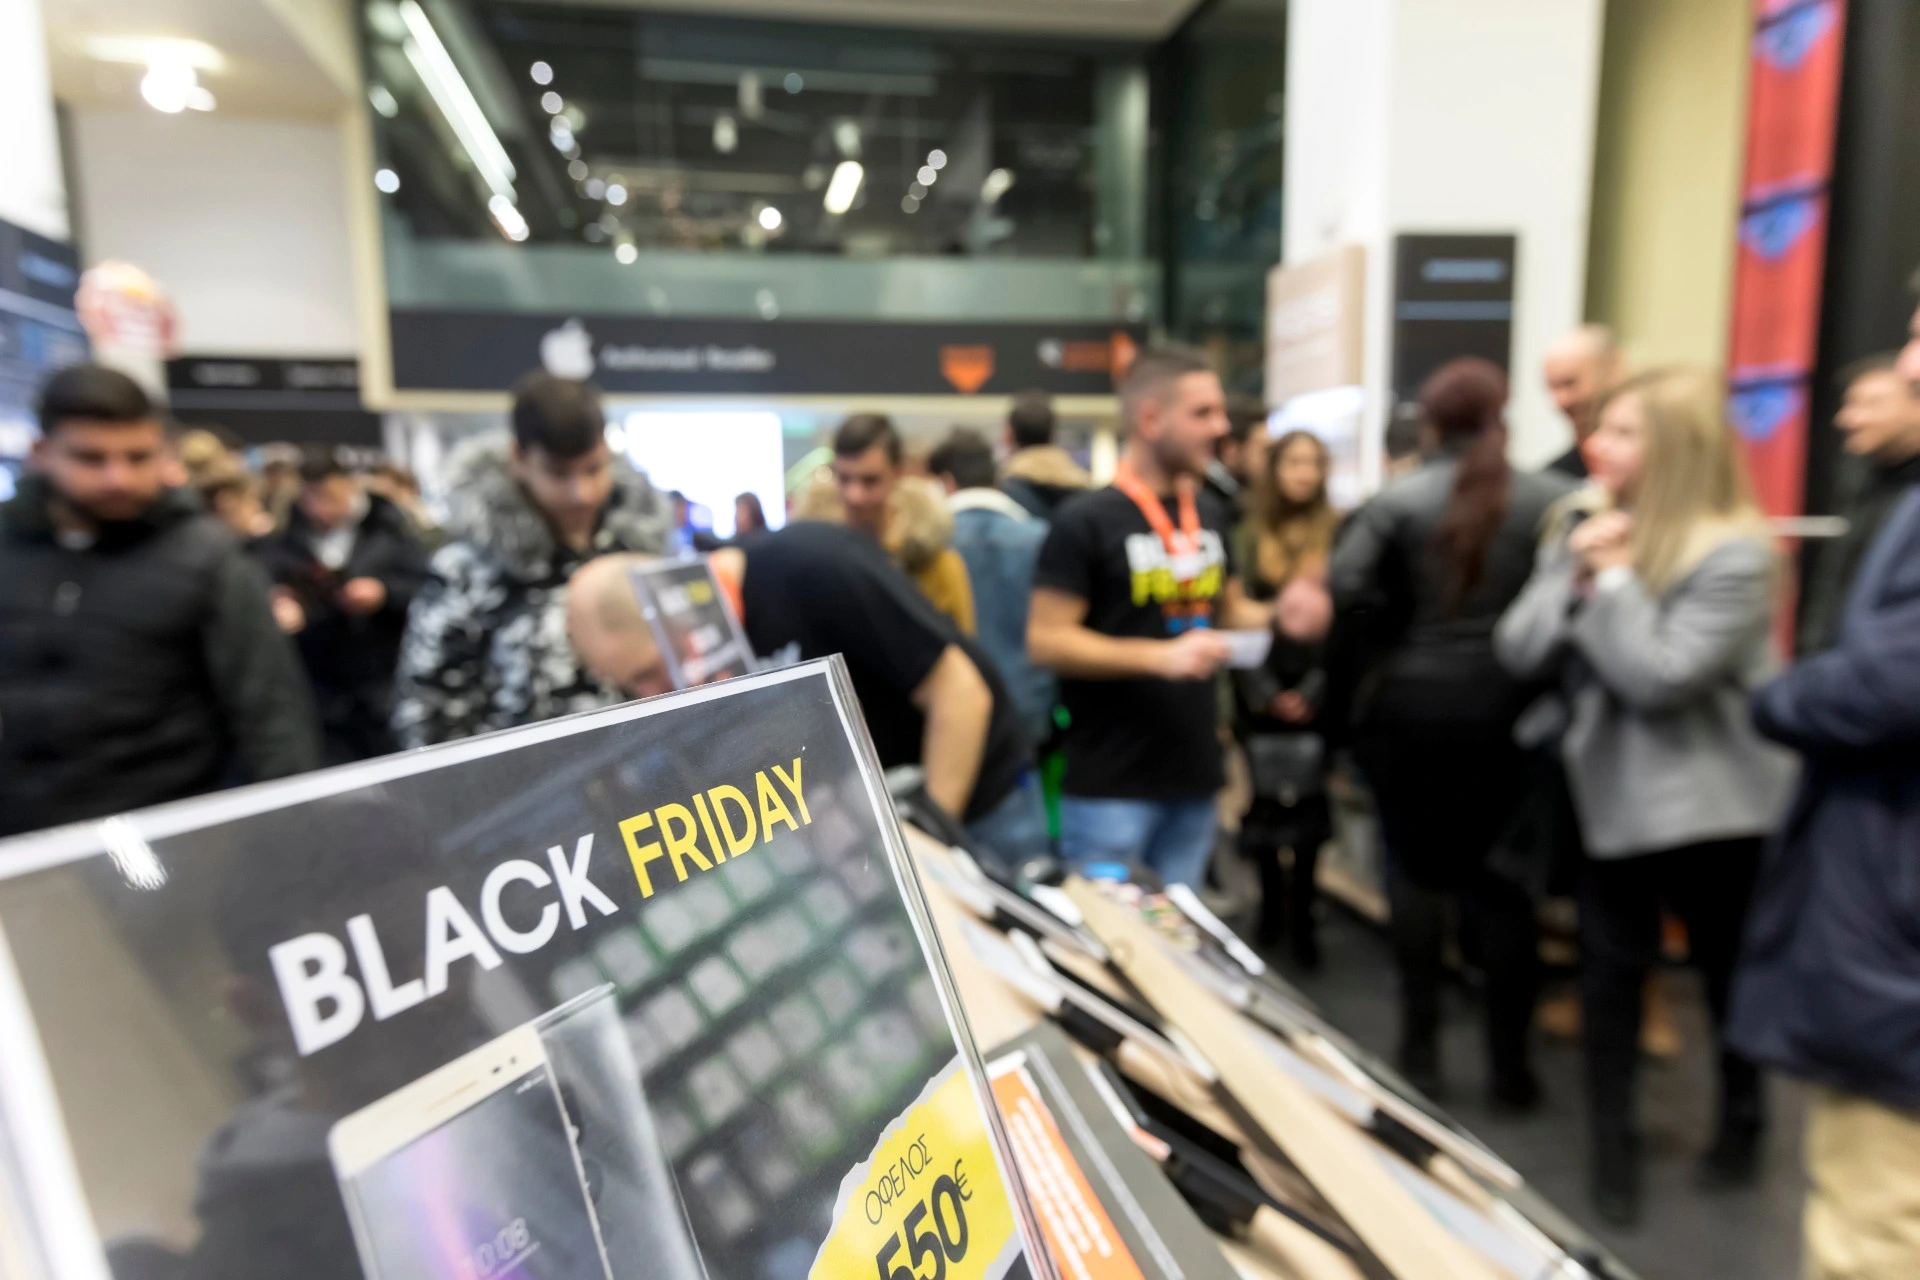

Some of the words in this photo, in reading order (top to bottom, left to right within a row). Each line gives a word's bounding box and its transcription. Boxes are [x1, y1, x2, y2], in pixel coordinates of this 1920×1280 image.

[269, 833, 619, 1055] BLACK
[619, 758, 813, 898] FRIDAY
[865, 1133, 933, 1225] ΟΦΕΛΟΣ
